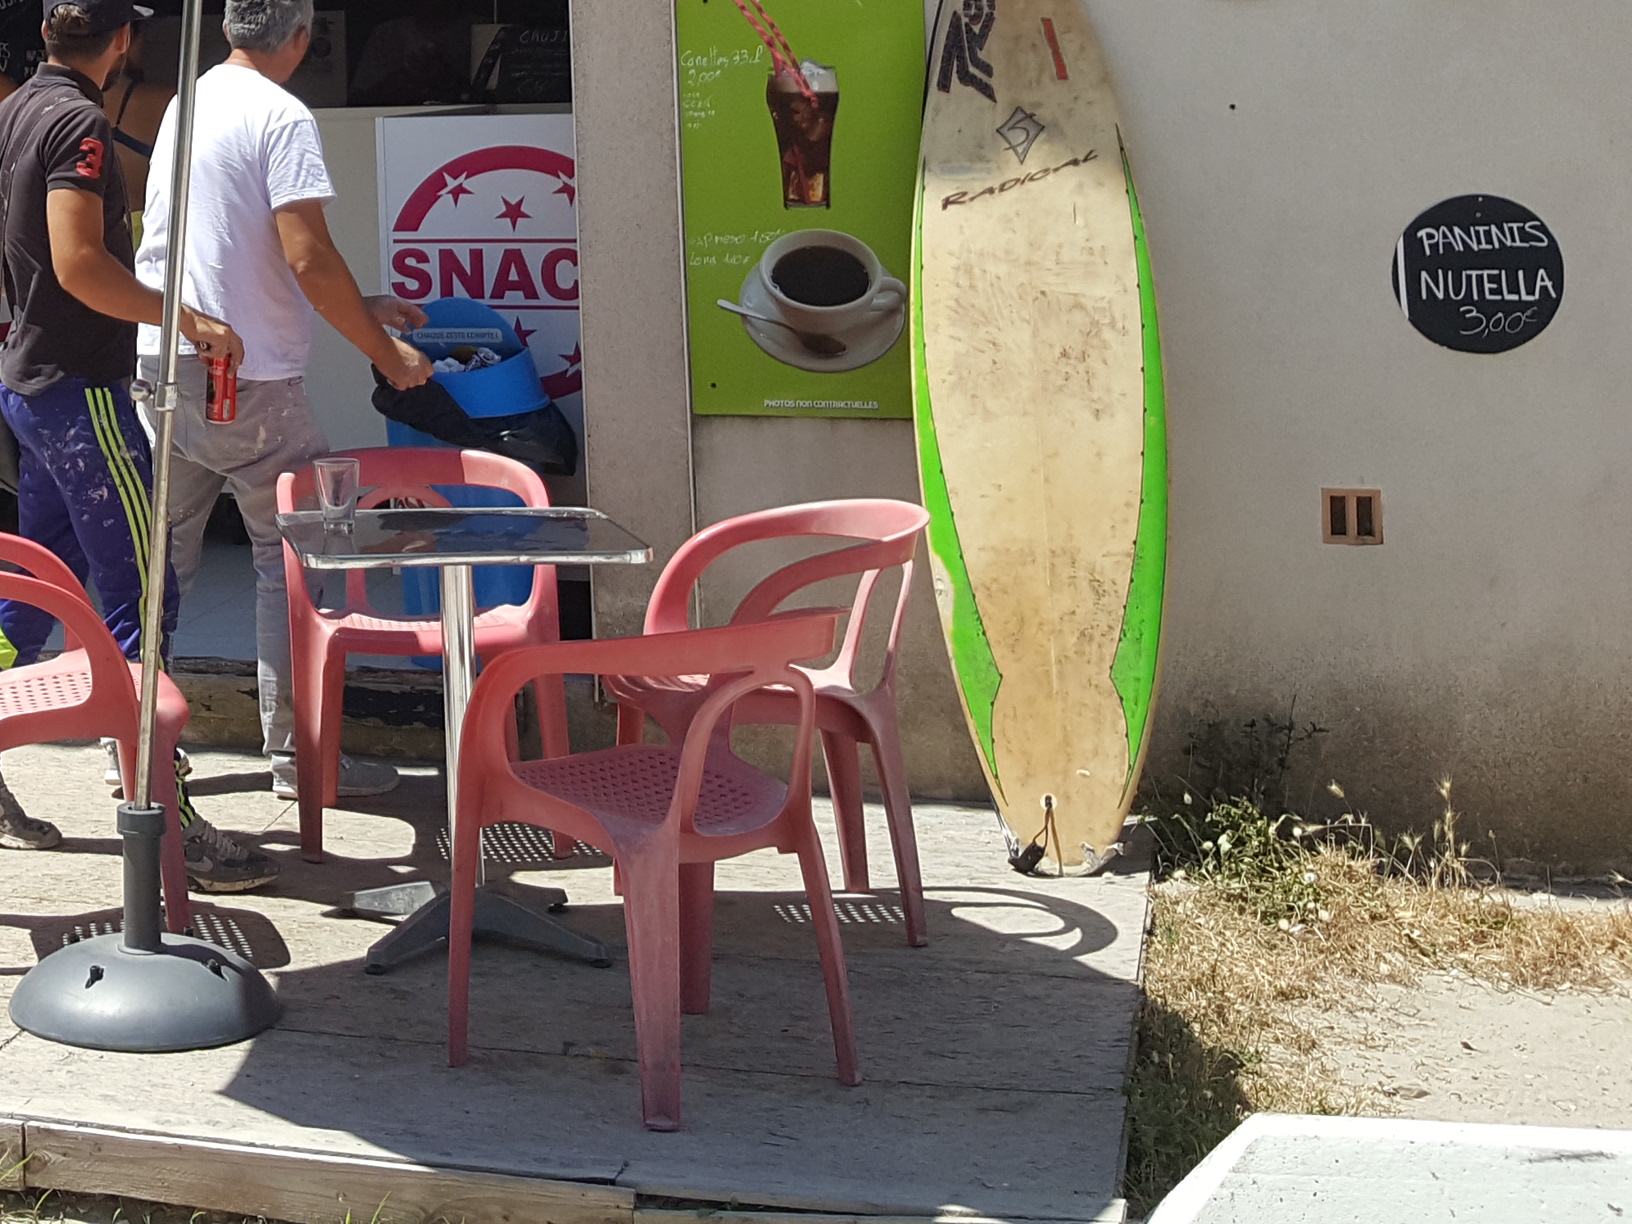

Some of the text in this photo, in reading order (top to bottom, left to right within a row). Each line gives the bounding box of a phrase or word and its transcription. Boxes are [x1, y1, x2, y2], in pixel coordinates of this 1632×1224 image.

[75, 137, 106, 180] 3
[941, 148, 1100, 212] RADICAL
[1416, 221, 1550, 258] PANINIS
[1419, 268, 1558, 302] NUTELLA
[764, 399, 796, 408] PHOTOS
